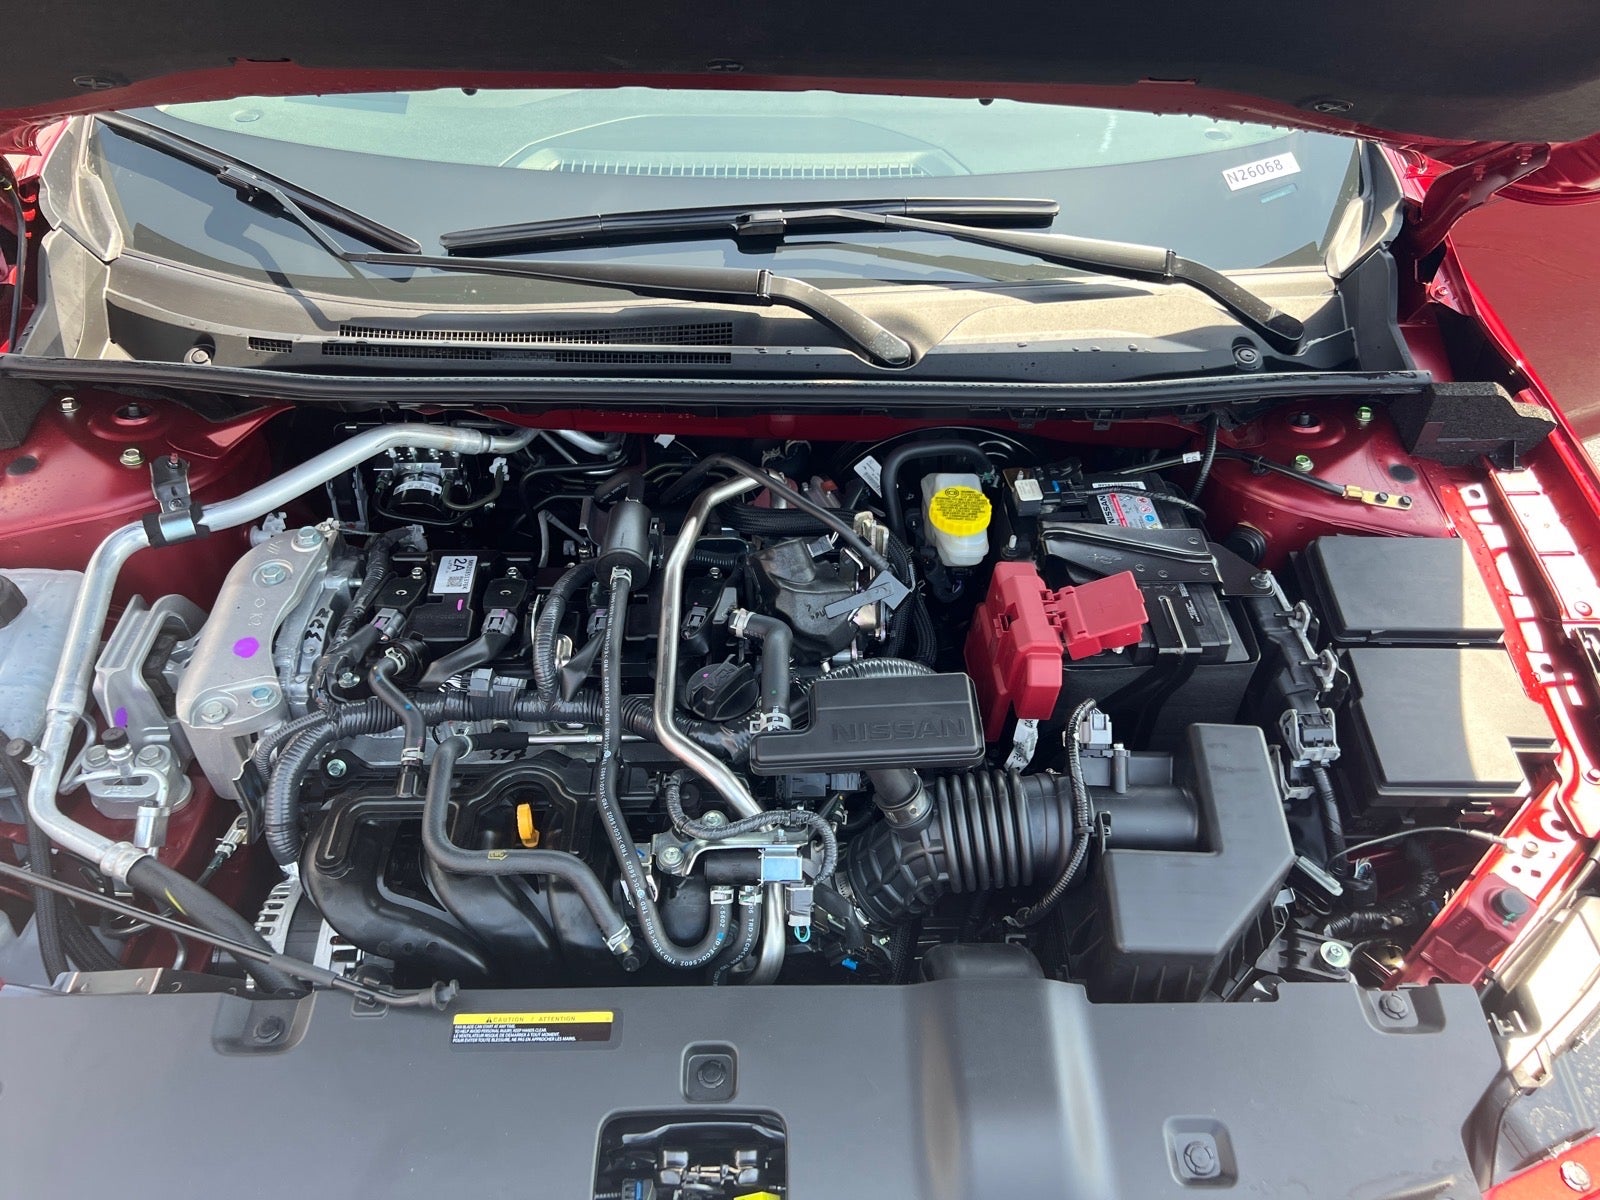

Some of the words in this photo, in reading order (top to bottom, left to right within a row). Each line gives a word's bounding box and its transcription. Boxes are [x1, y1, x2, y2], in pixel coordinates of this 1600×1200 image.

[1226, 159, 1283, 185] N26068
[1099, 495, 1115, 524] NISSAN
[831, 718, 967, 743] NISSAN
